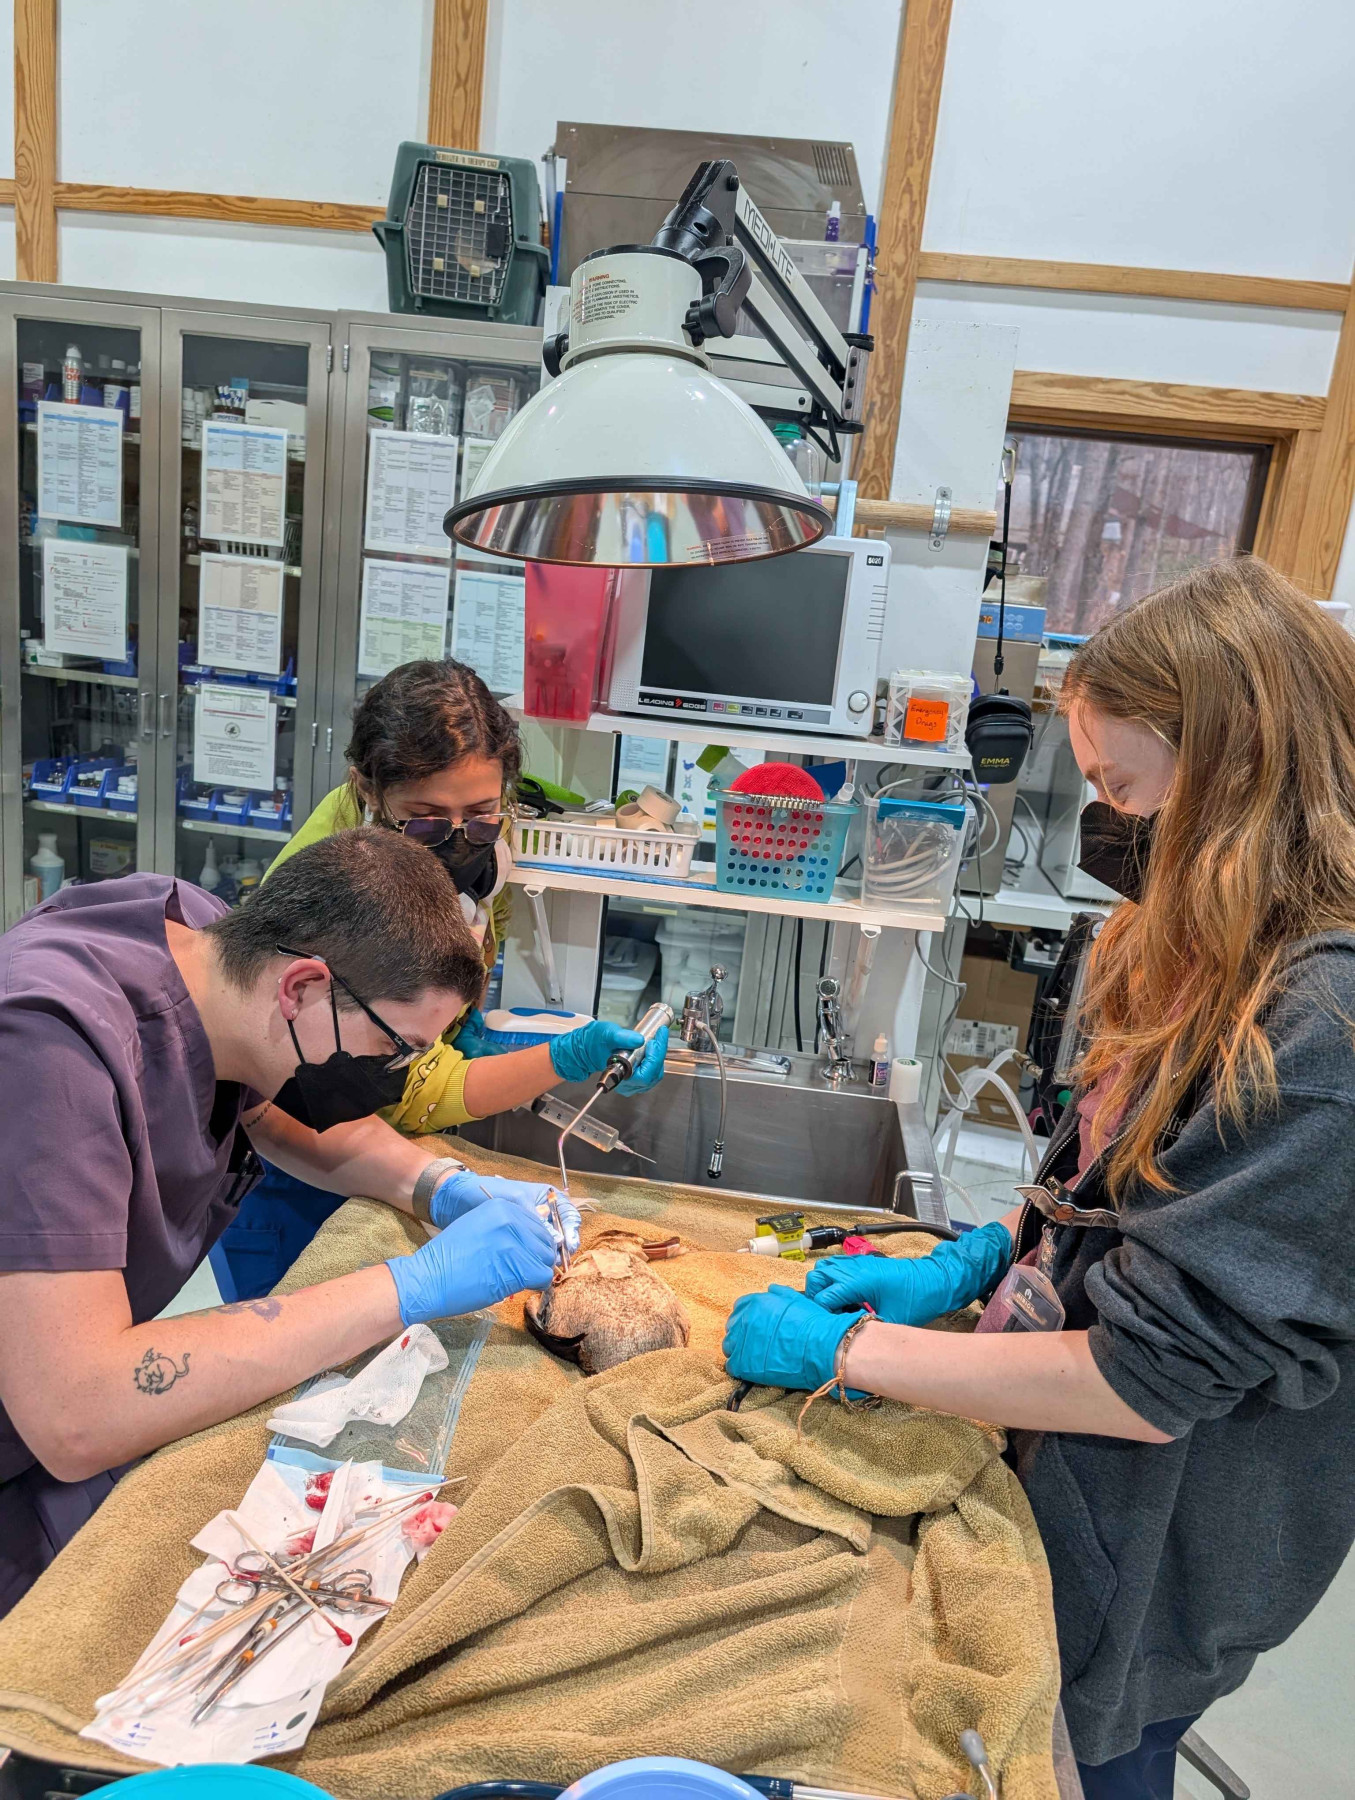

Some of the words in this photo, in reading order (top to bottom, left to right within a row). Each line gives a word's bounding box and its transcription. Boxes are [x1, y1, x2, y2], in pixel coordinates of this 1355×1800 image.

[589, 274, 609, 282] WARNING
[638, 697, 673, 706] LEADING
[911, 704, 944, 718] Emergency
[916, 717, 936, 730] Drugs
